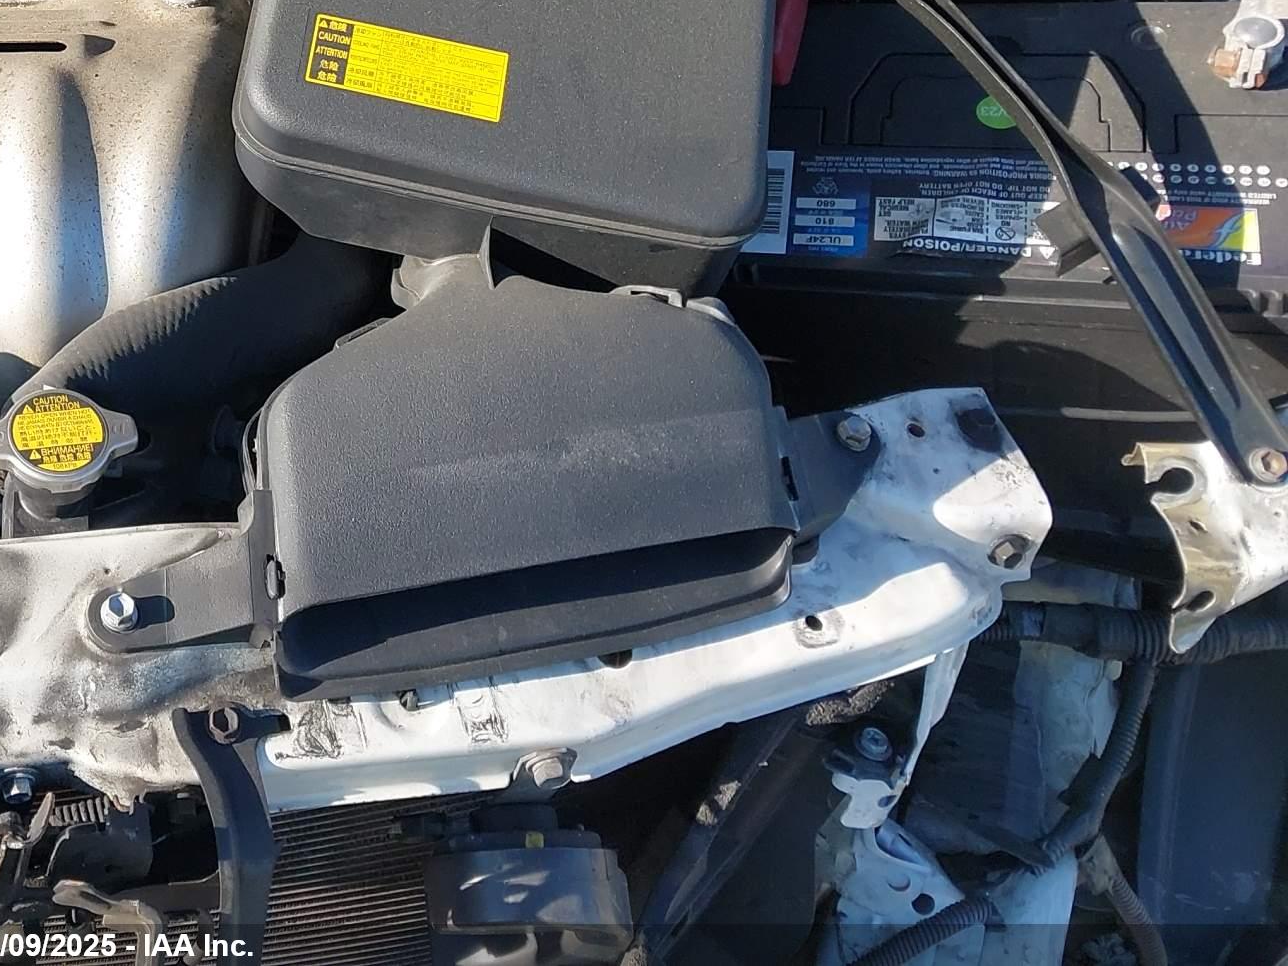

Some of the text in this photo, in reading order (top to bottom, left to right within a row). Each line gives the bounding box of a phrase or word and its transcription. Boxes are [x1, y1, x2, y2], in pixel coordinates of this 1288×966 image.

[318, 31, 351, 45] CAUTION
[315, 45, 348, 60] ATTENTION
[815, 217, 835, 225] 810
[902, 238, 1032, 258] DANGER/POISON
[33, 394, 69, 406] CAUTION
[35, 401, 81, 413] ATTENTION
[40, 443, 94, 457] ВНИМАНИЕ!
